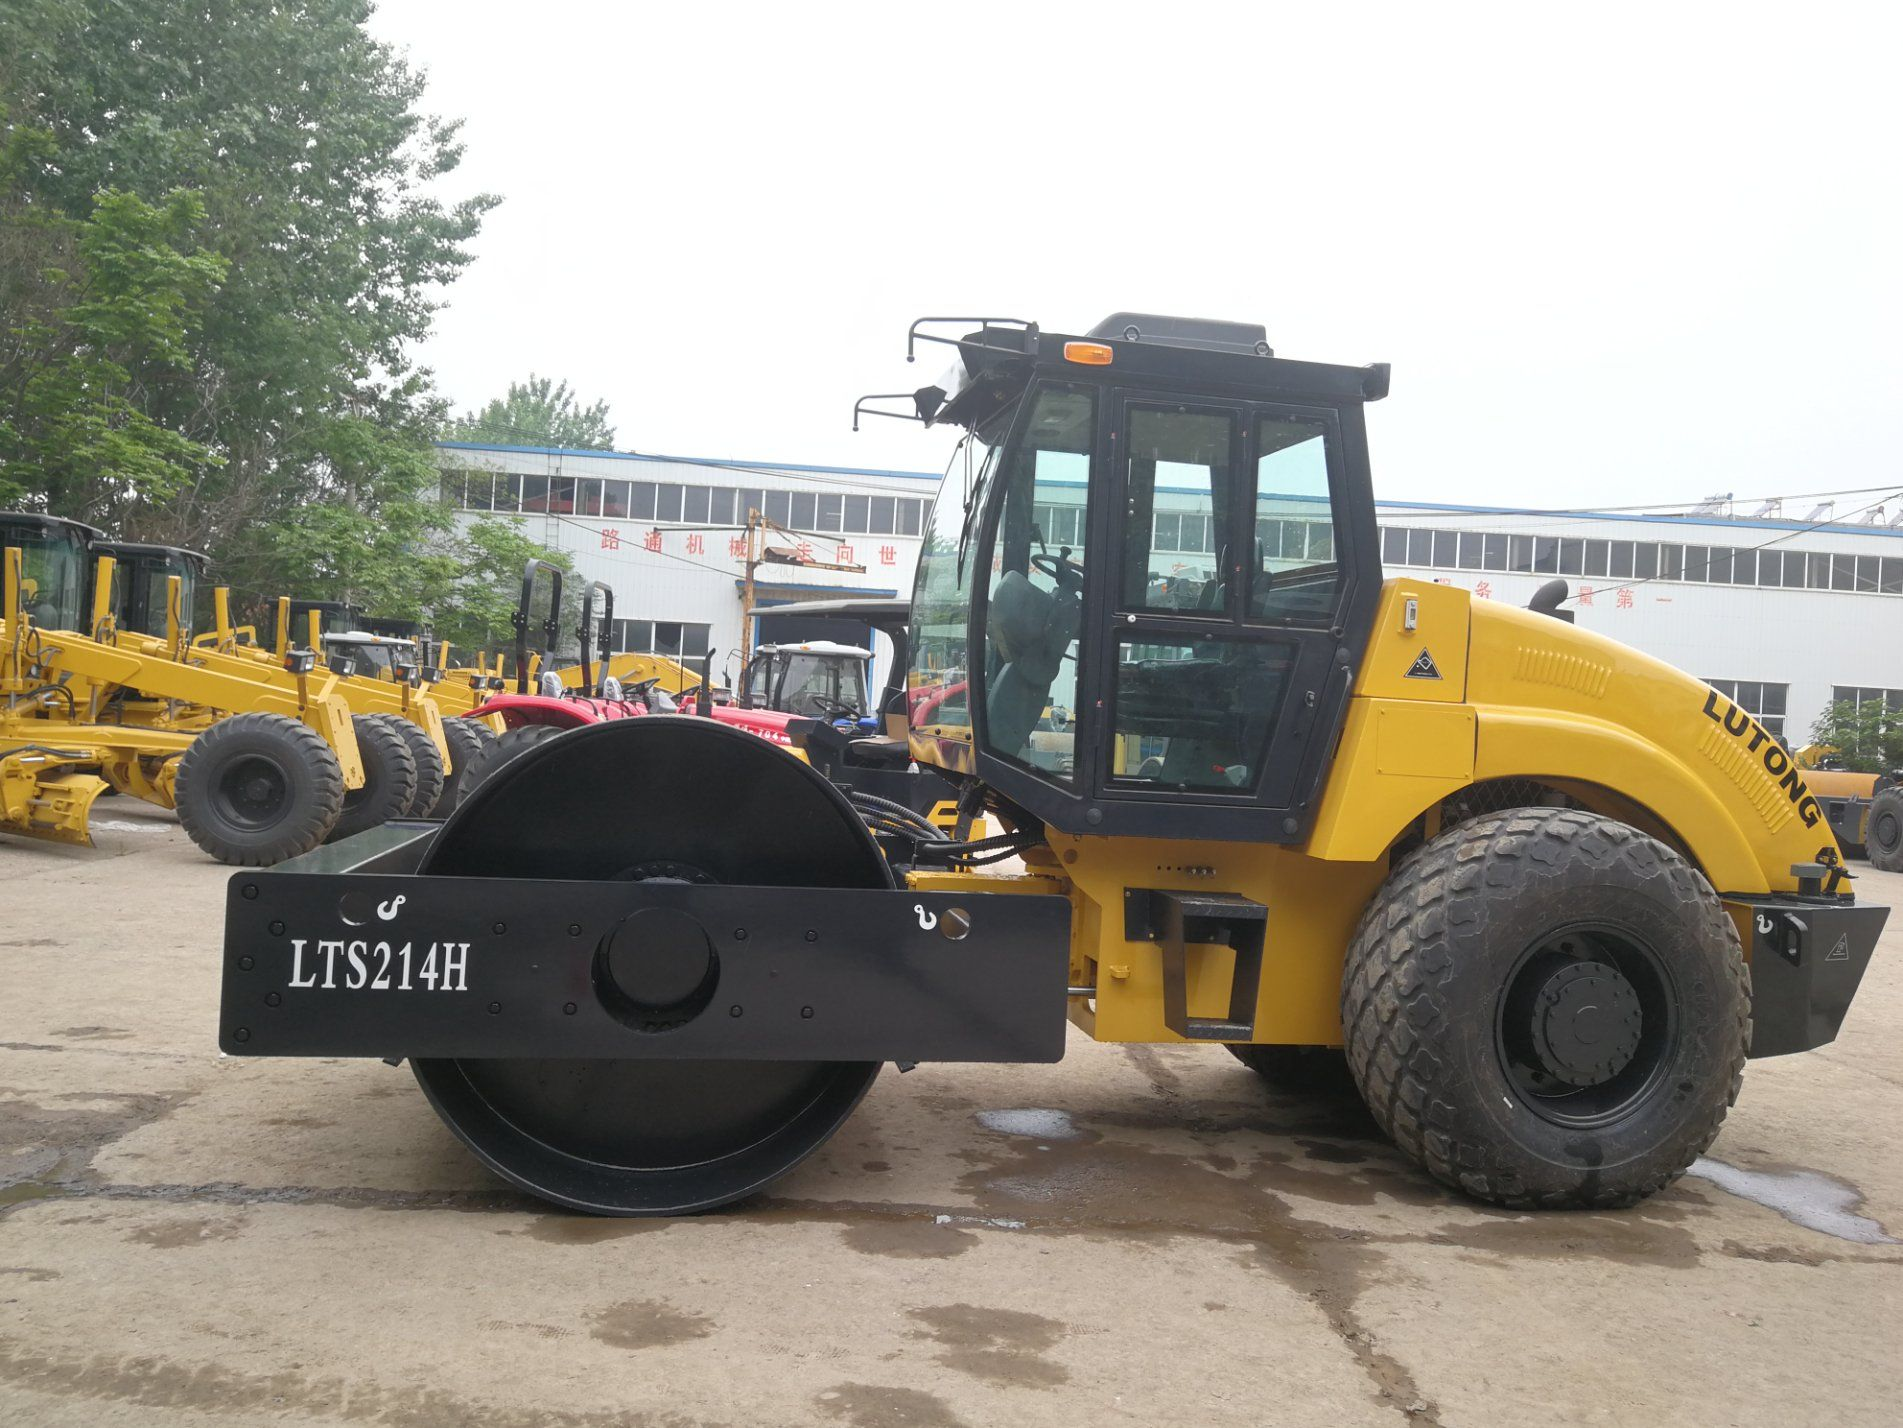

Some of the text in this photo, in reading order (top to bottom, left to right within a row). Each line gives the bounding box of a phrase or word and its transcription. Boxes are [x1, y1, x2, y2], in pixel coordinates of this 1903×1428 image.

[601, 528, 748, 557] 路通机械
[1539, 583, 1673, 609] 量第一
[1702, 690, 1822, 829] LUTONG
[288, 939, 470, 991] LTS214H
